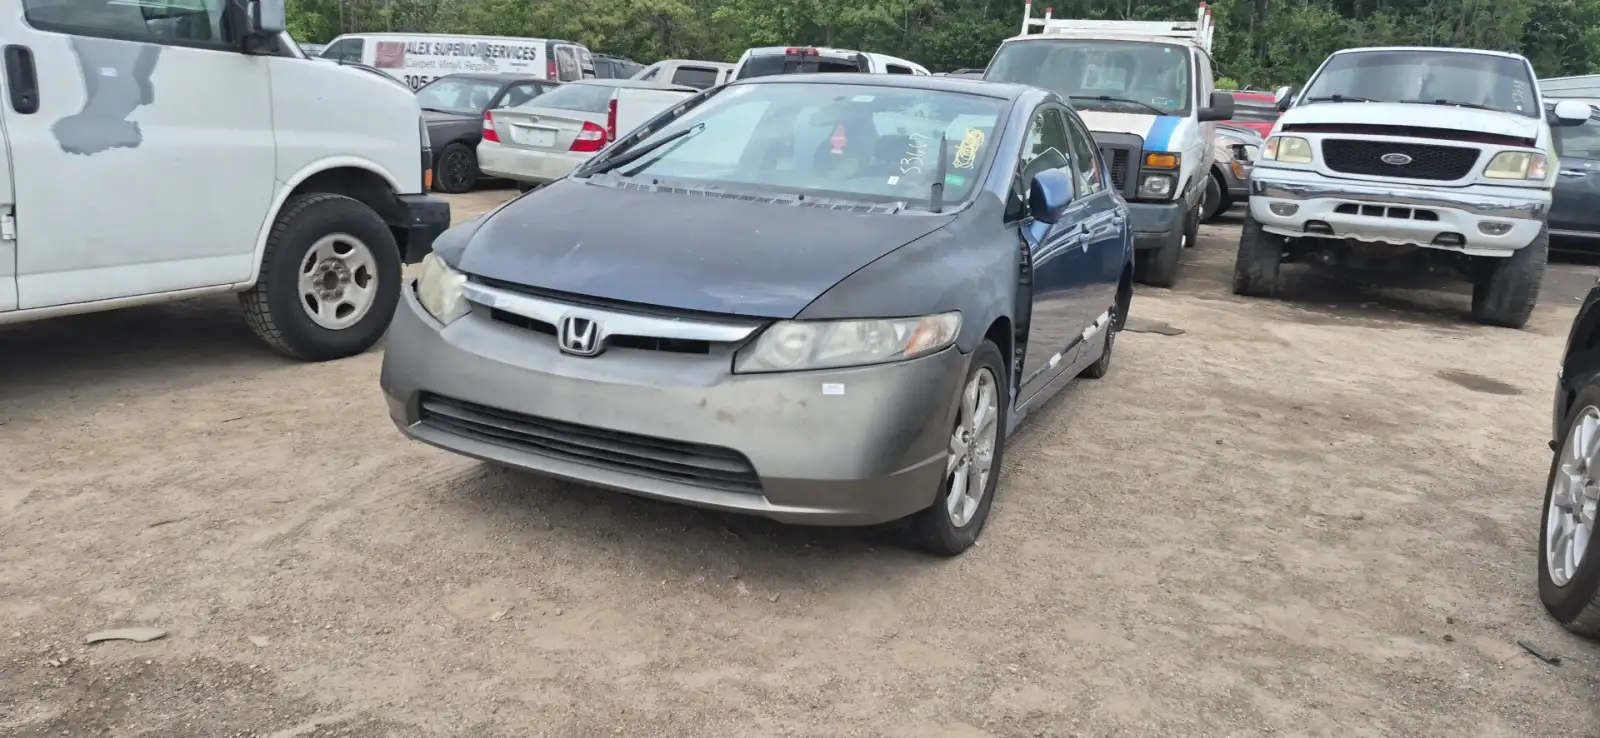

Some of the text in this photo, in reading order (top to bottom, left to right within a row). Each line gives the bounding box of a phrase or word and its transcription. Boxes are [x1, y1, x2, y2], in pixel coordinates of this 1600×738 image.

[405, 41, 536, 61] ALEX SUPEIO SERVICES
